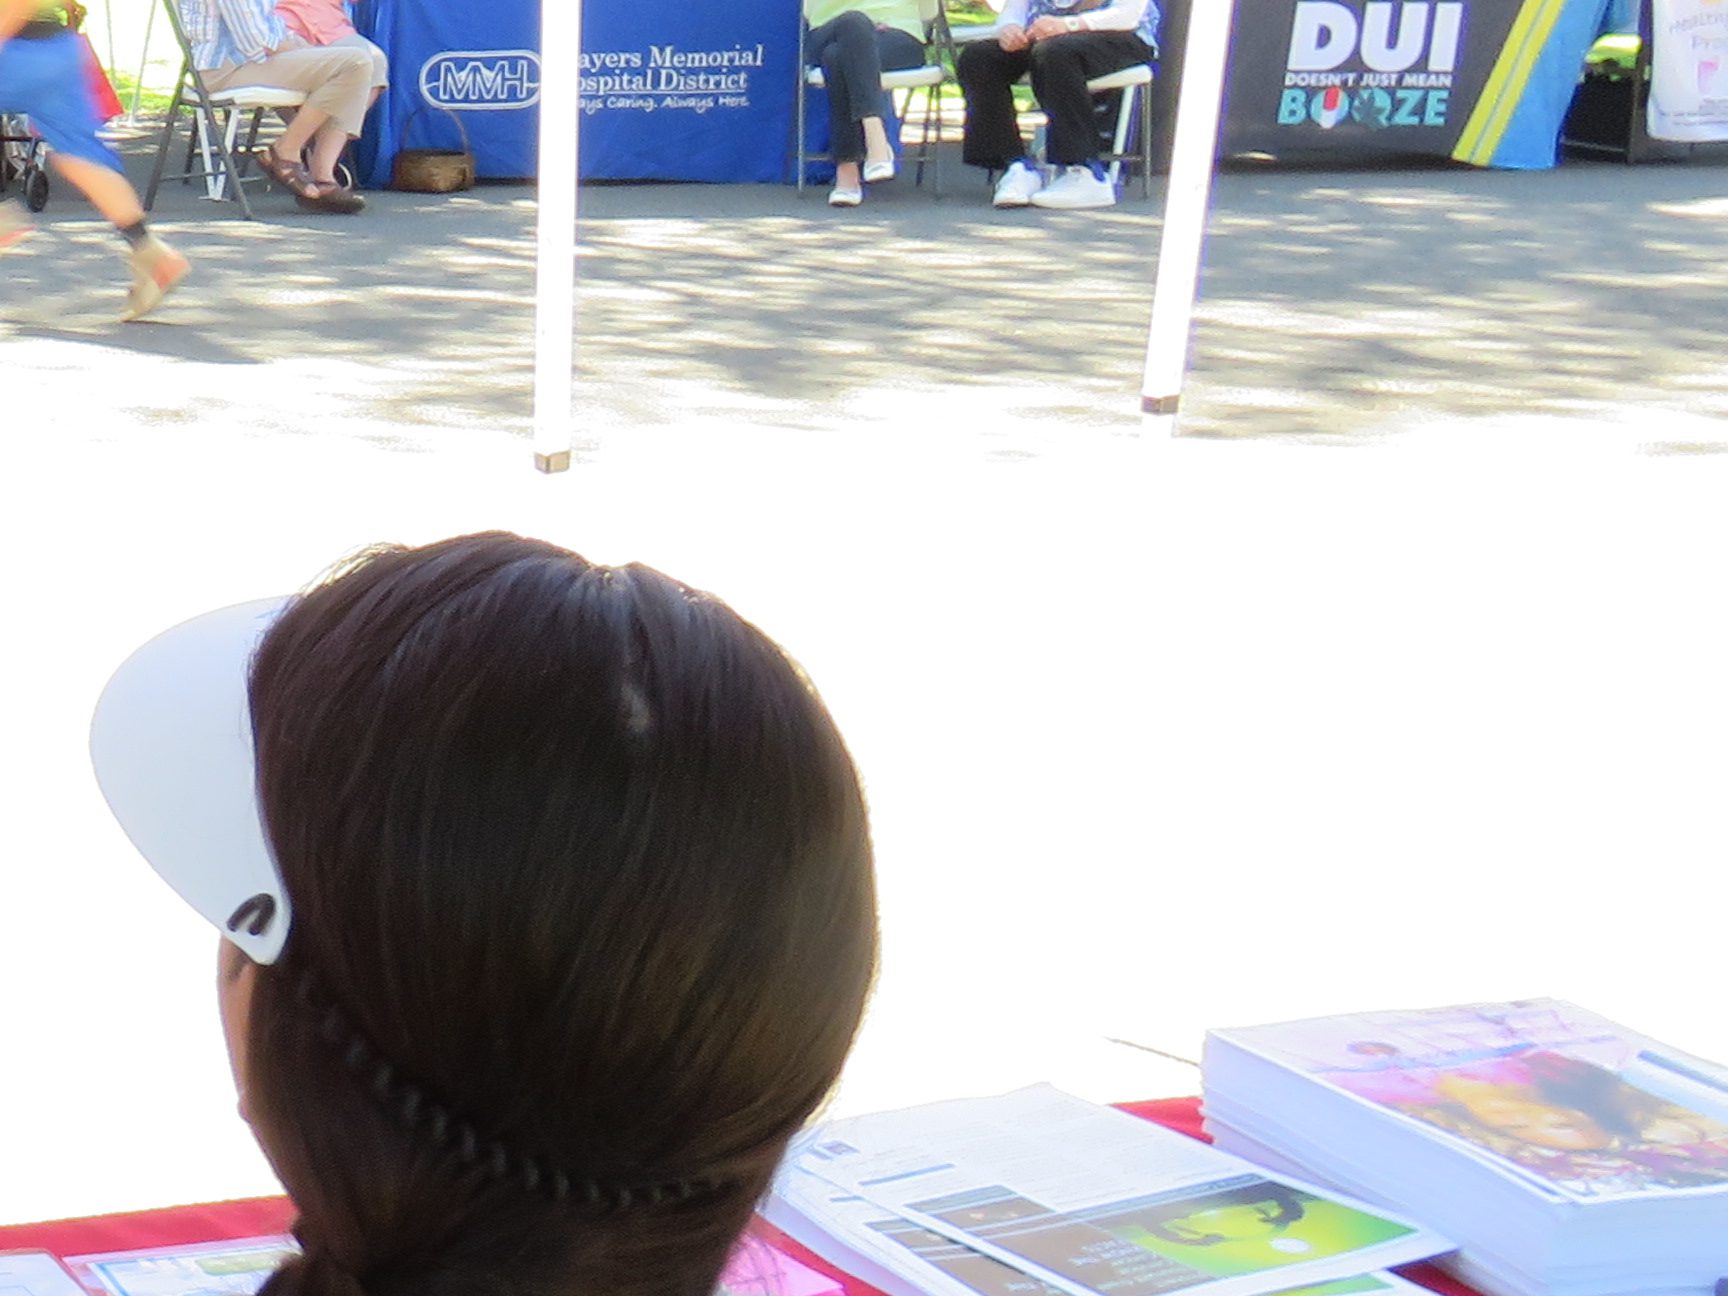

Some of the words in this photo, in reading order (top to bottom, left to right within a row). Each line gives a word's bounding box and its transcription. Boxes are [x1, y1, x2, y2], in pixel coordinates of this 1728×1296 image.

[1287, 1, 1463, 72] DUI
[579, 49, 642, 72] ayers
[649, 43, 765, 68] Memorial
[438, 60, 528, 100] MMH
[578, 68, 653, 95] ospital
[659, 68, 749, 92] District
[1284, 72, 1354, 87] DOESN'T
[1359, 72, 1399, 87] JUST
[1402, 72, 1453, 87] MEAN
[606, 96, 658, 113] Caring.
[661, 95, 715, 114] Always
[1277, 86, 1450, 129] BOOZE
